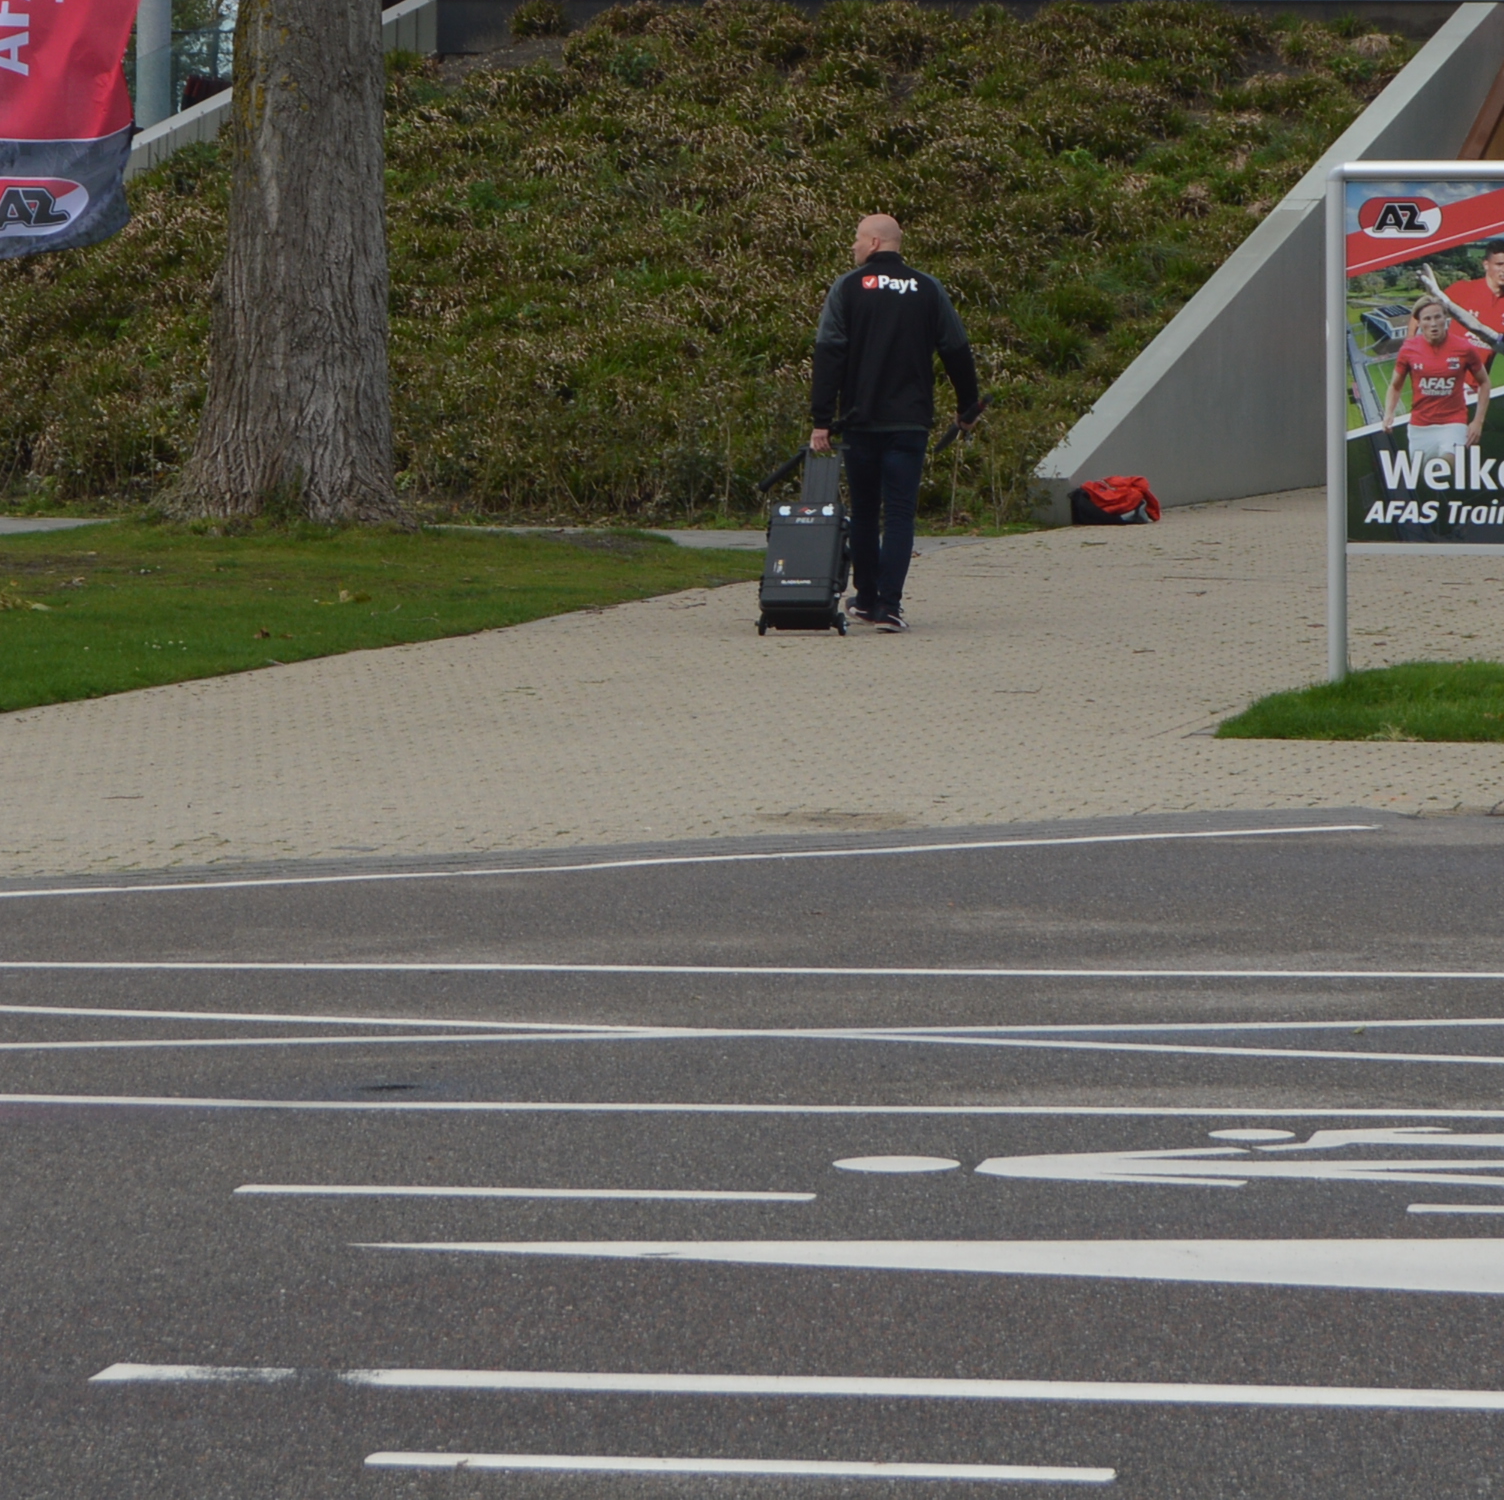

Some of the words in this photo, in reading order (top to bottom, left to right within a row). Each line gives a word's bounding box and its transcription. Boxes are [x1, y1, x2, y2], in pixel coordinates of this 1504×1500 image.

[1373, 201, 1431, 233] AZ
[877, 274, 918, 295] Payt
[1419, 377, 1456, 390] AFAS
[1364, 500, 1439, 524] AFAS
